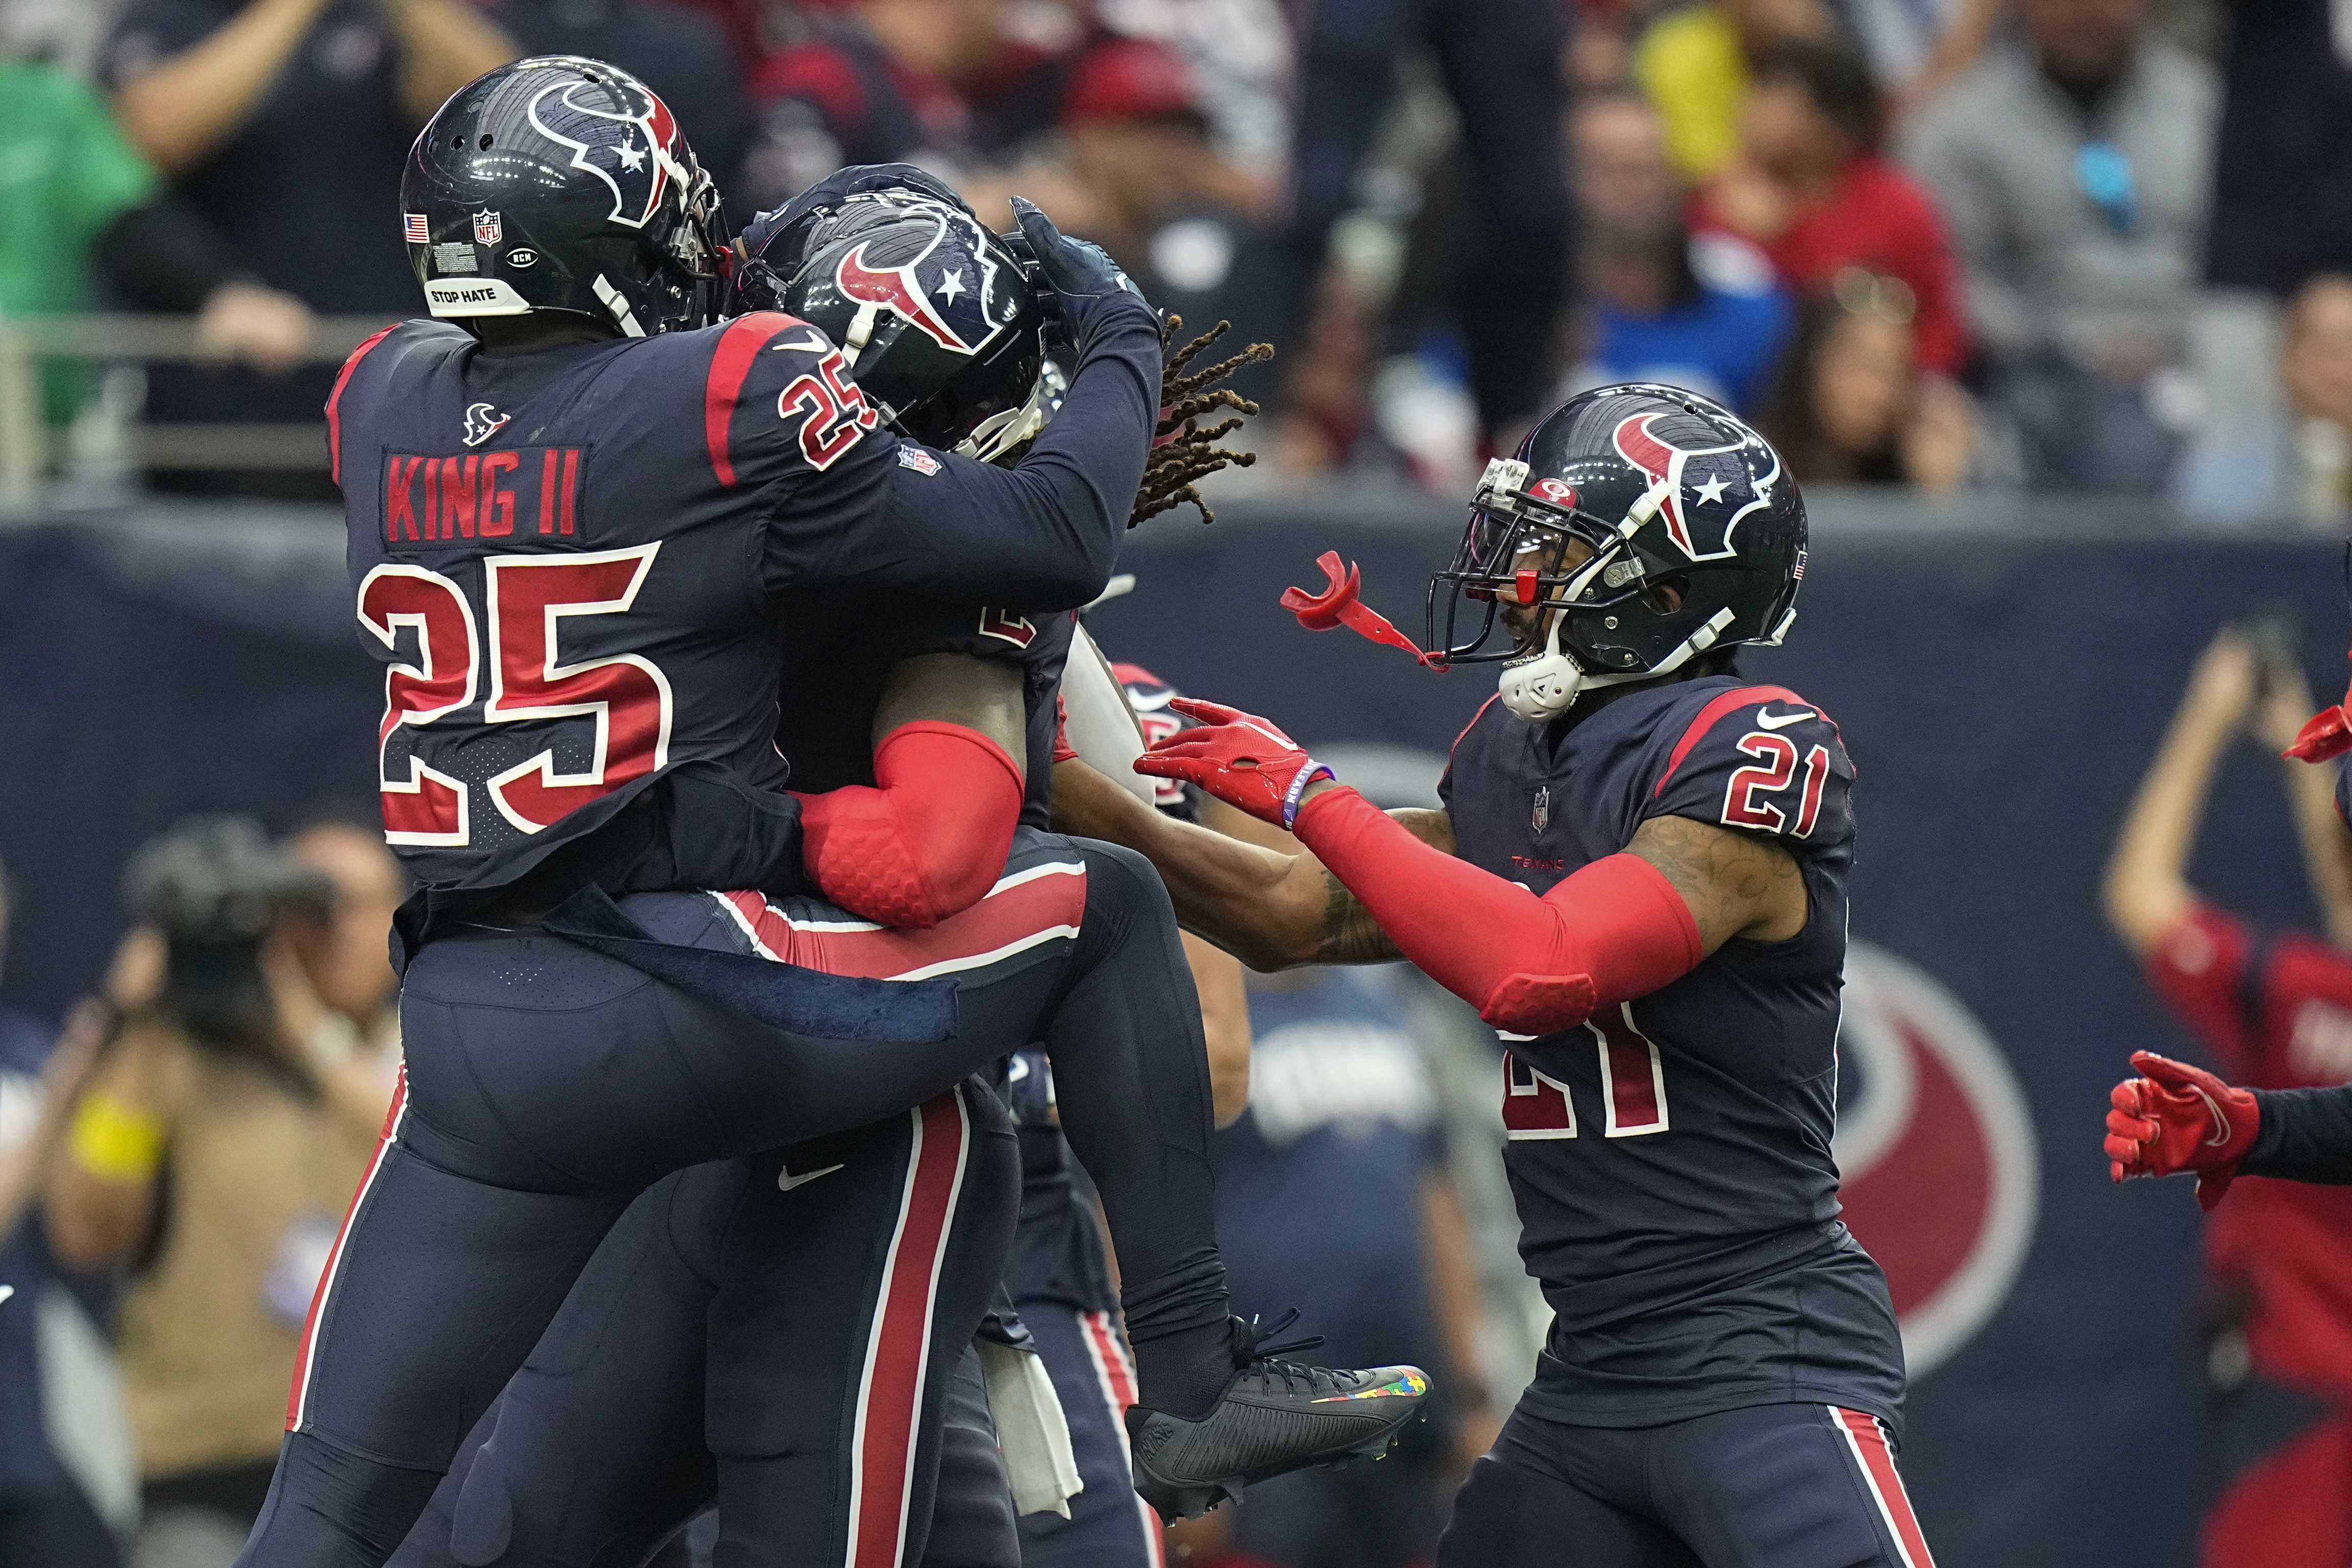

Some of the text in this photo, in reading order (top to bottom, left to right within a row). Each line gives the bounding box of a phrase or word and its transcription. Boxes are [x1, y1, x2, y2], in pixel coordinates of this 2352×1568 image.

[478, 226, 498, 240] NFL
[513, 253, 531, 262] RCM
[431, 288, 496, 303] STOP HATE
[778, 347, 878, 471] 25
[915, 453, 934, 472] NFL
[387, 449, 579, 542] KING II
[357, 540, 673, 846] 25
[1287, 769, 1309, 804] LEARN
[1720, 732, 1829, 839] 21
[1512, 855, 1564, 869] TEXANS
[1138, 1419, 1173, 1461] NIKE
